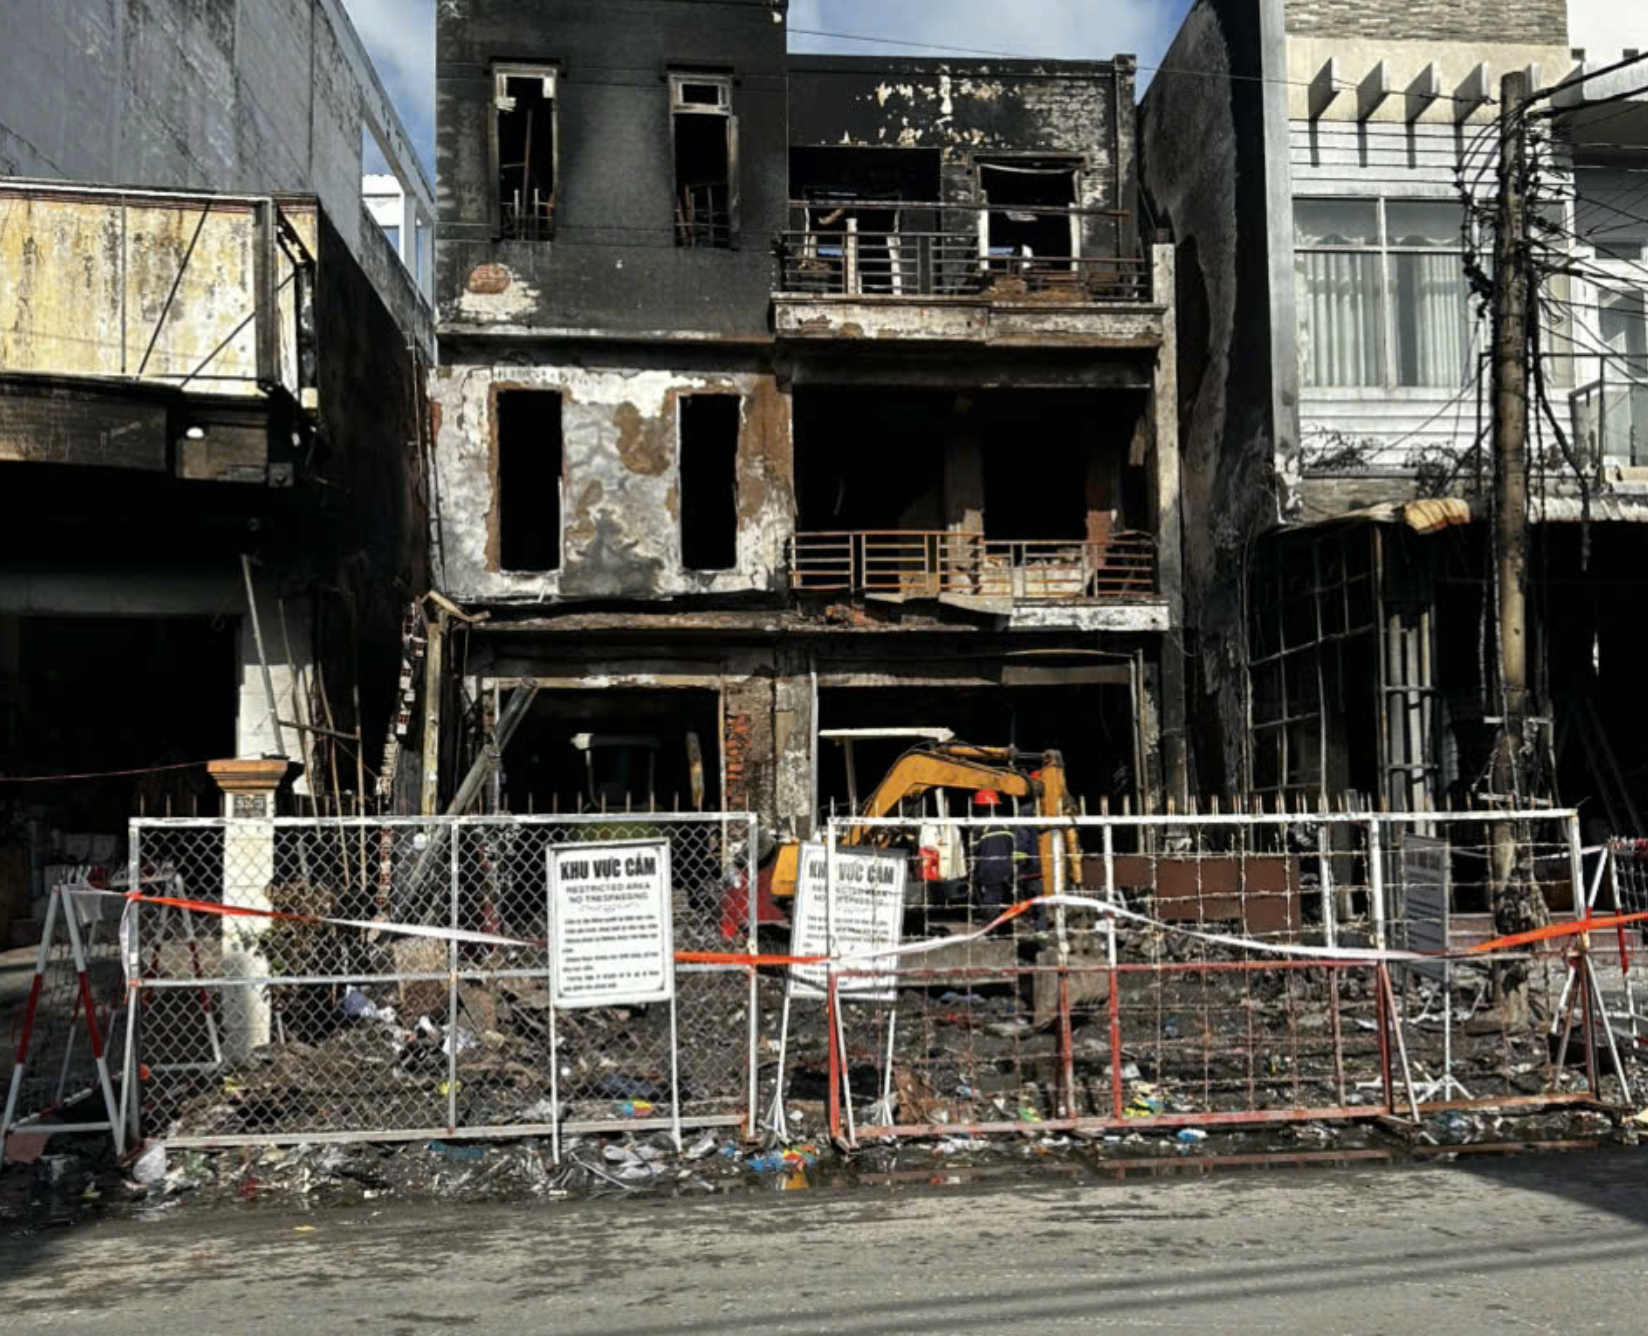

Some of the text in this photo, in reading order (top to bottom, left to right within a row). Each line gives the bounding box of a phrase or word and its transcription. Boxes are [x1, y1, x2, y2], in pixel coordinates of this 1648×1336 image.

[560, 860, 589, 880] KHU
[566, 882, 651, 894] RESTRICTED AREA
[569, 895, 583, 904] NO
